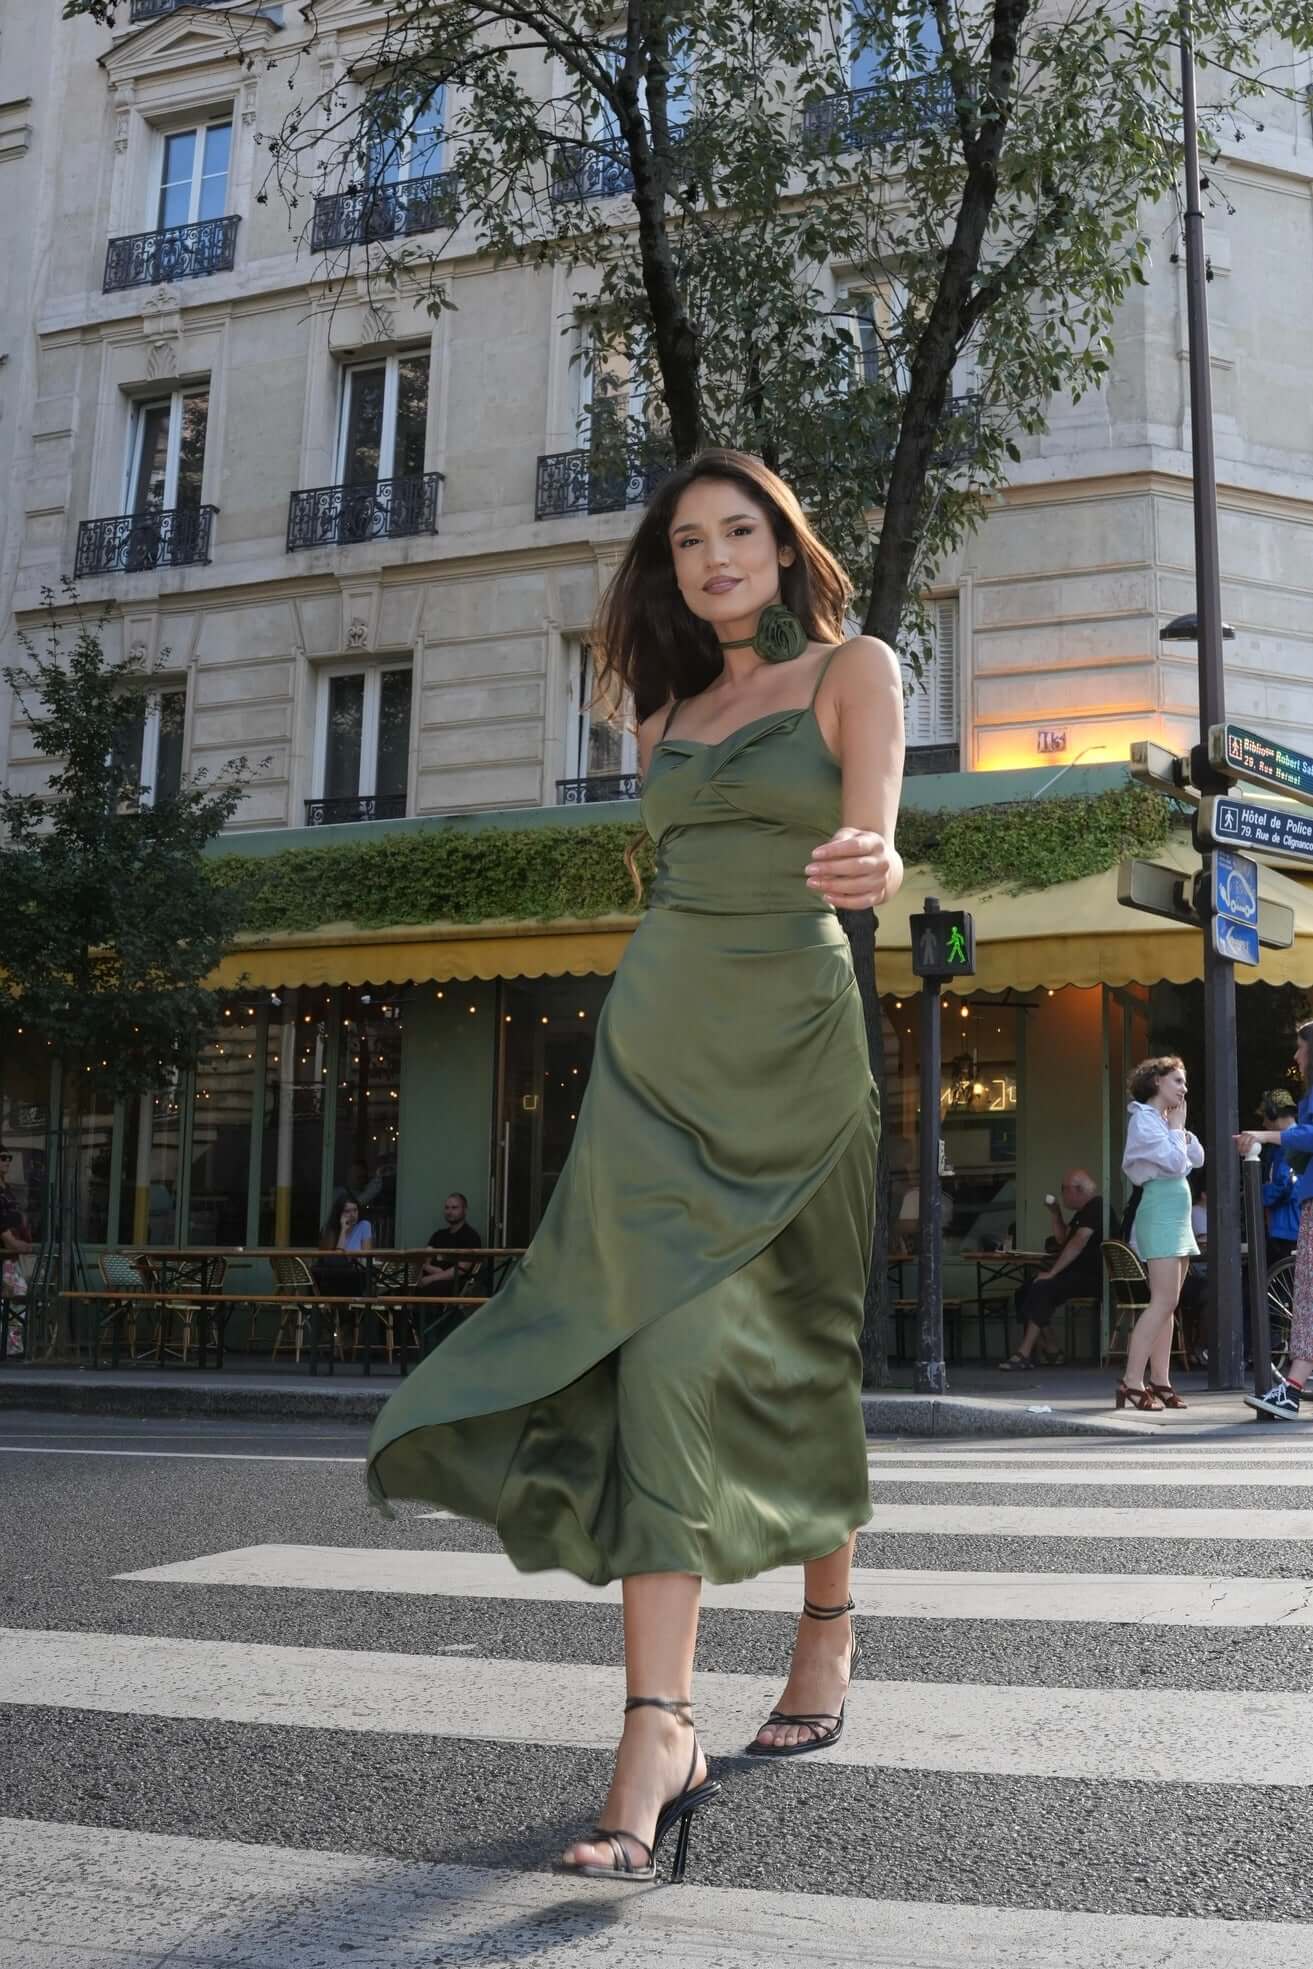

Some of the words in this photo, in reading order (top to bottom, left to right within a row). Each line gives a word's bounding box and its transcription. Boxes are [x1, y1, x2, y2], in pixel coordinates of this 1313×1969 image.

[1259, 761, 1273, 775] Rue
[1276, 751, 1300, 770] Robert
[1241, 808, 1267, 826] Hôtel
[1270, 816, 1281, 829] de
[1286, 819, 1312, 836] Police
[1255, 828, 1269, 841] Rue
[1272, 833, 1280, 843] de
